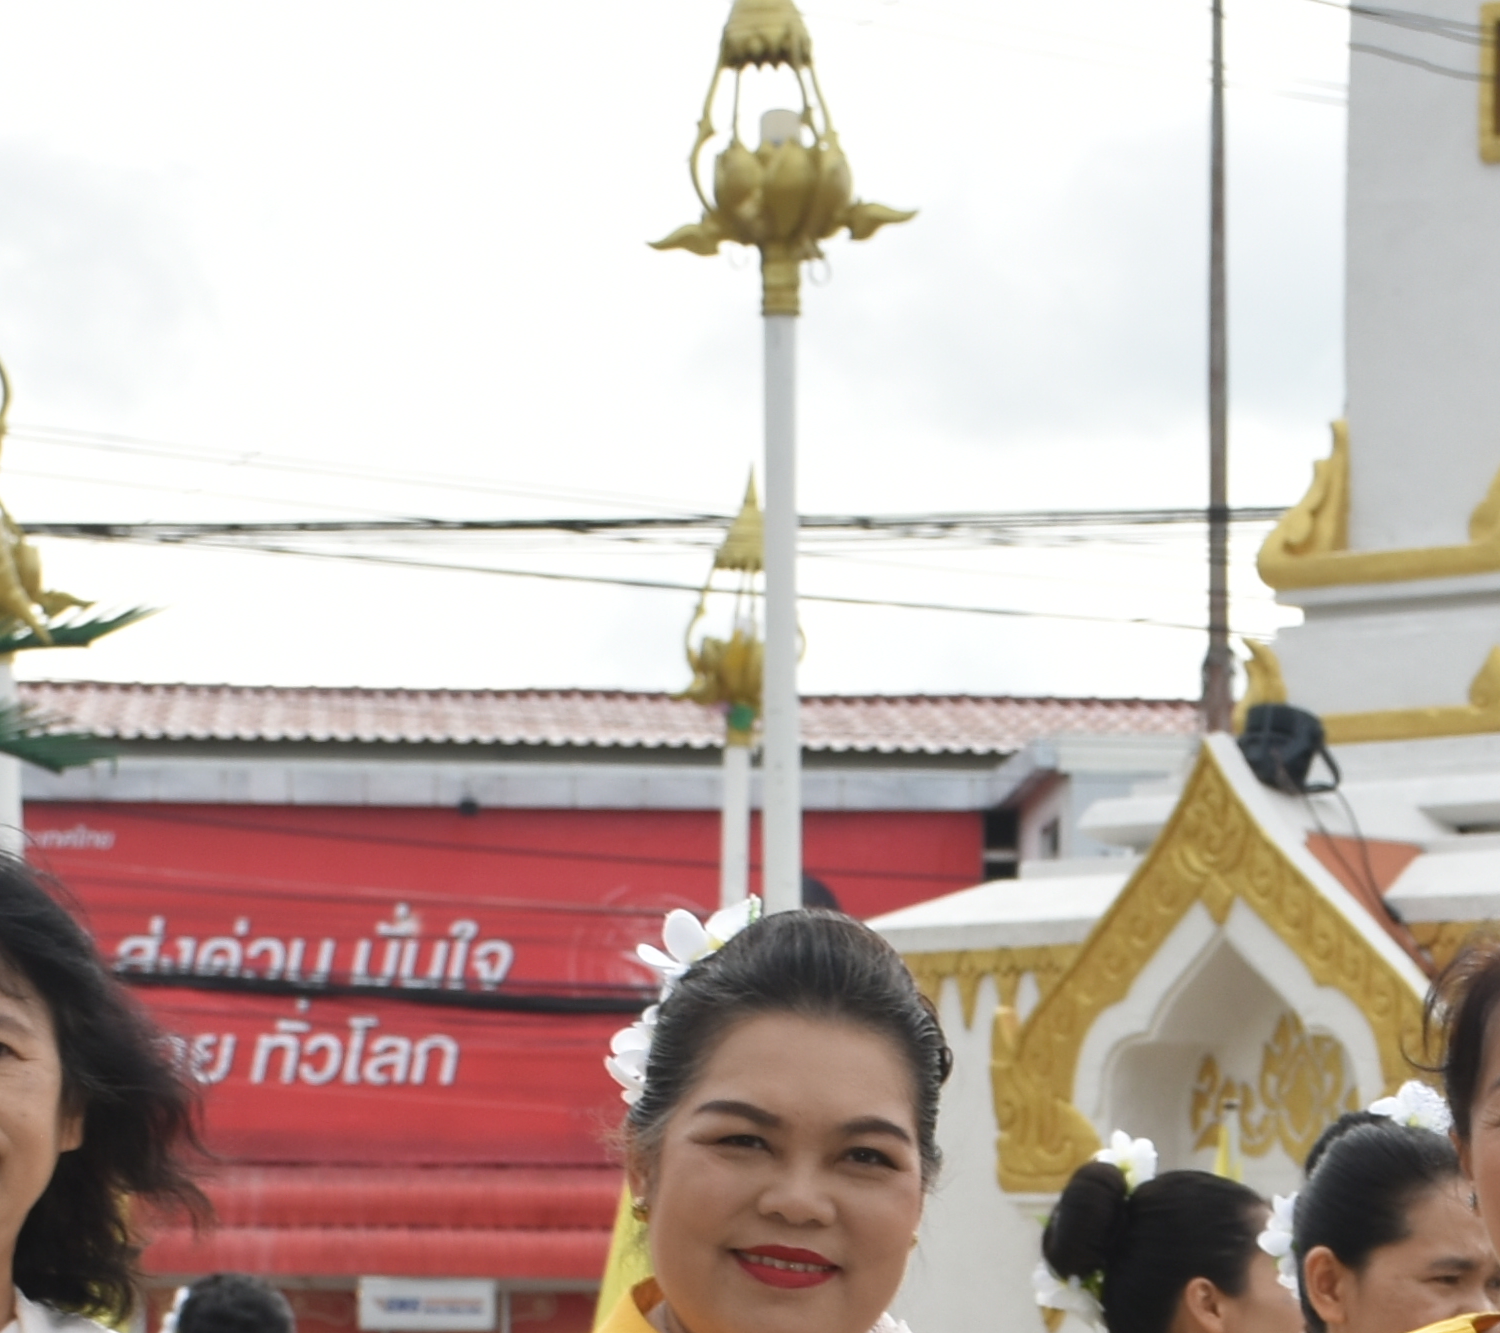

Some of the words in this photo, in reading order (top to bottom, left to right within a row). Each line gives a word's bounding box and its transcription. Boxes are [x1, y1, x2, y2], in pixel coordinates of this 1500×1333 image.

[349, 902, 514, 990] มั่นใจ
[249, 997, 460, 1085] ทั่วโลก
